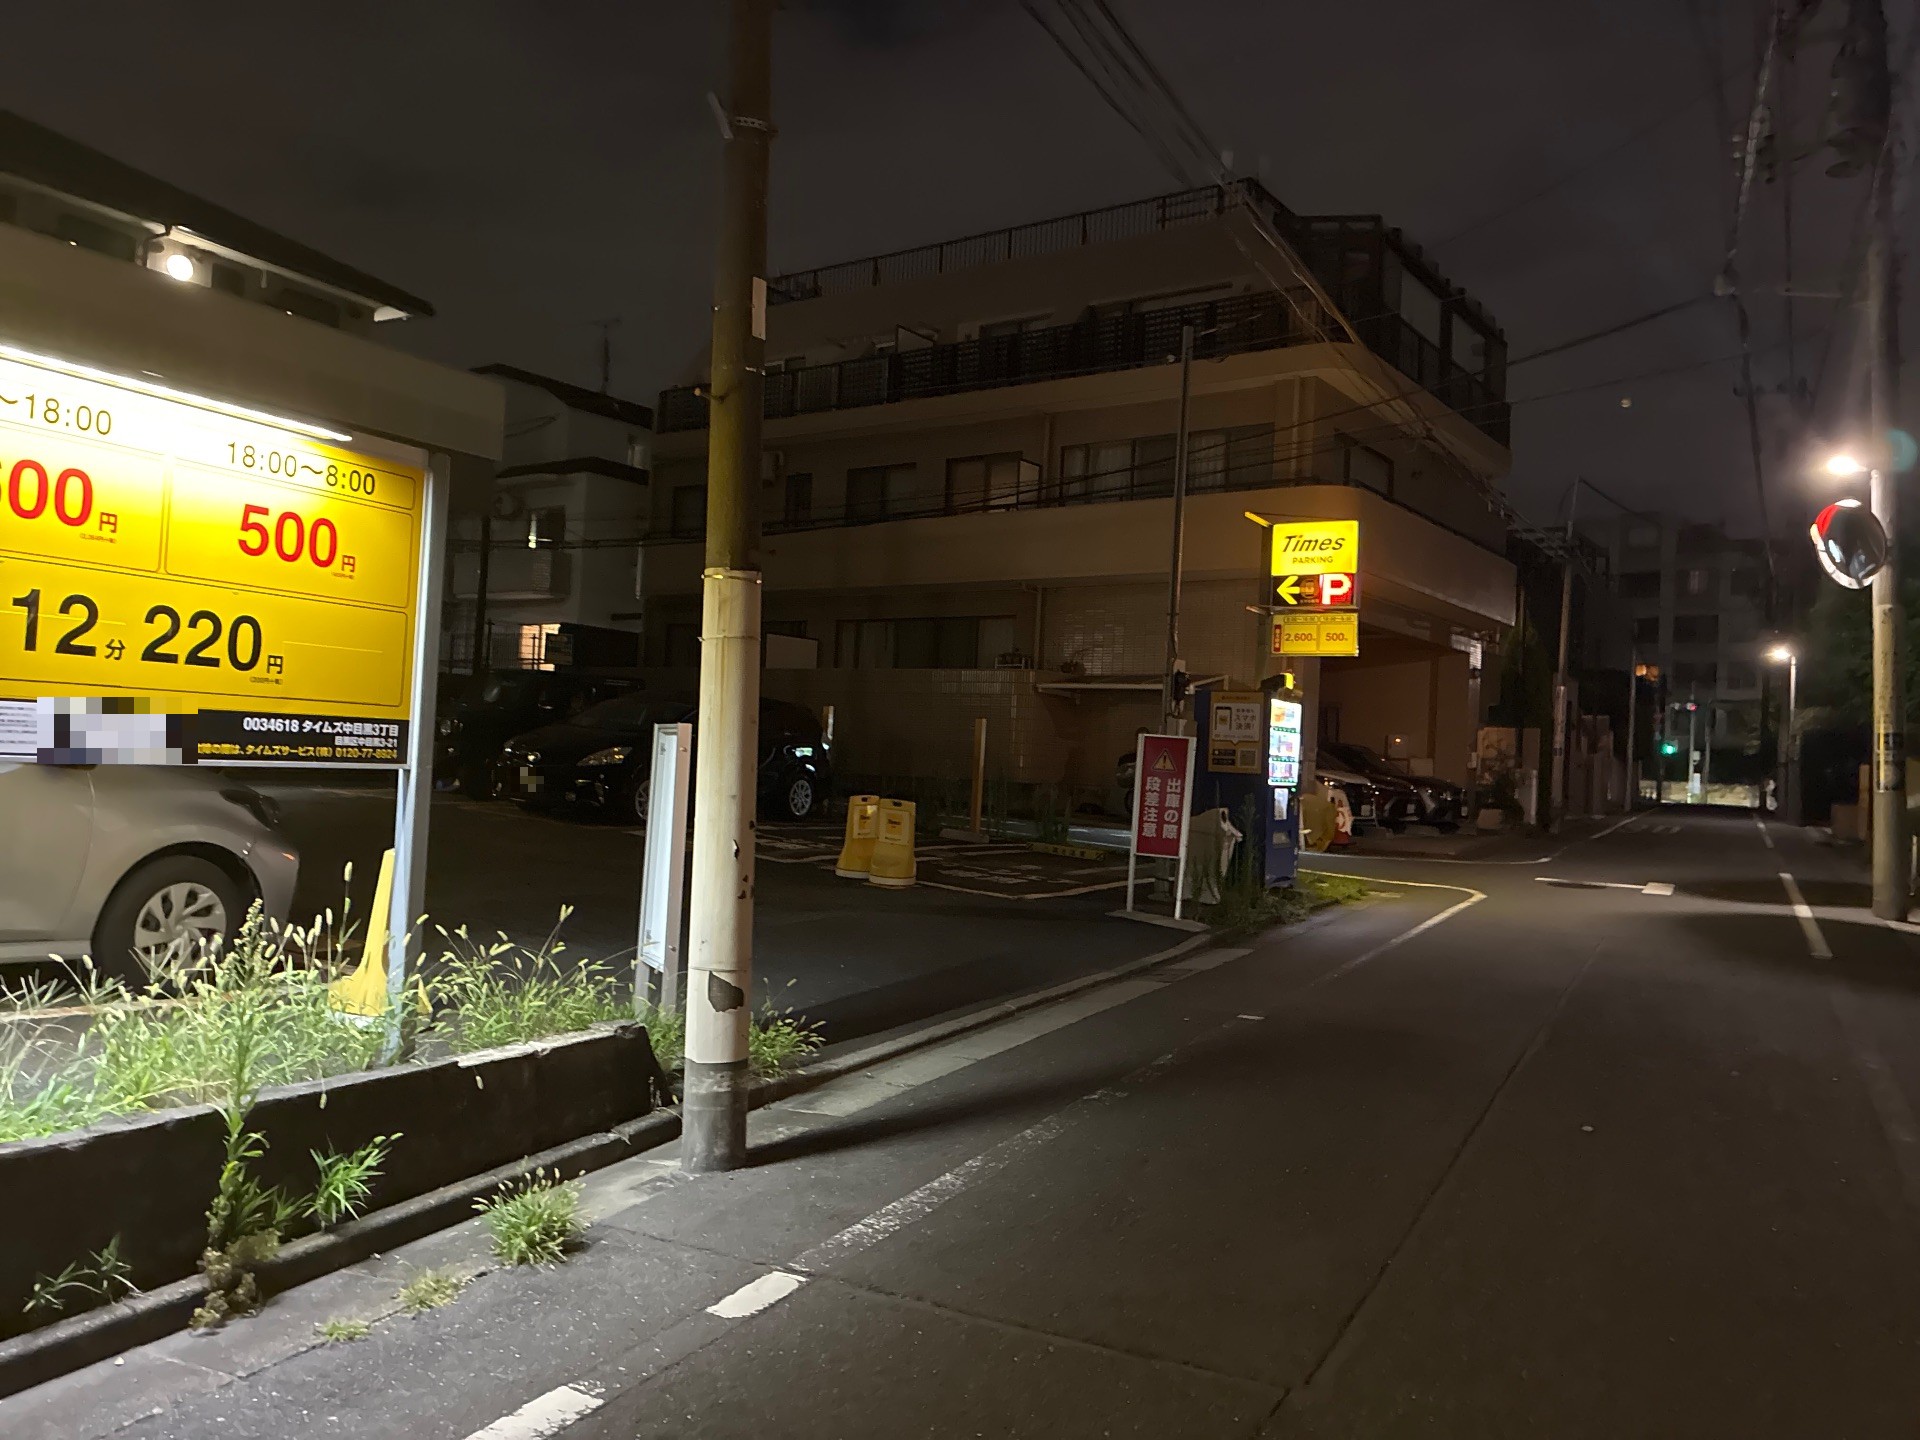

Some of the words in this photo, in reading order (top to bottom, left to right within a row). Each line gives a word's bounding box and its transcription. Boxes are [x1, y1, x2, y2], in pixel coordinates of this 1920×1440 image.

[1282, 535, 1346, 553] Times
[1292, 556, 1334, 564] PARKING
[1321, 573, 1352, 605] P
[242, 717, 300, 733] 0034618
[1142, 776, 1161, 838] 段差注意
[1162, 778, 1181, 839] 出庫の際
